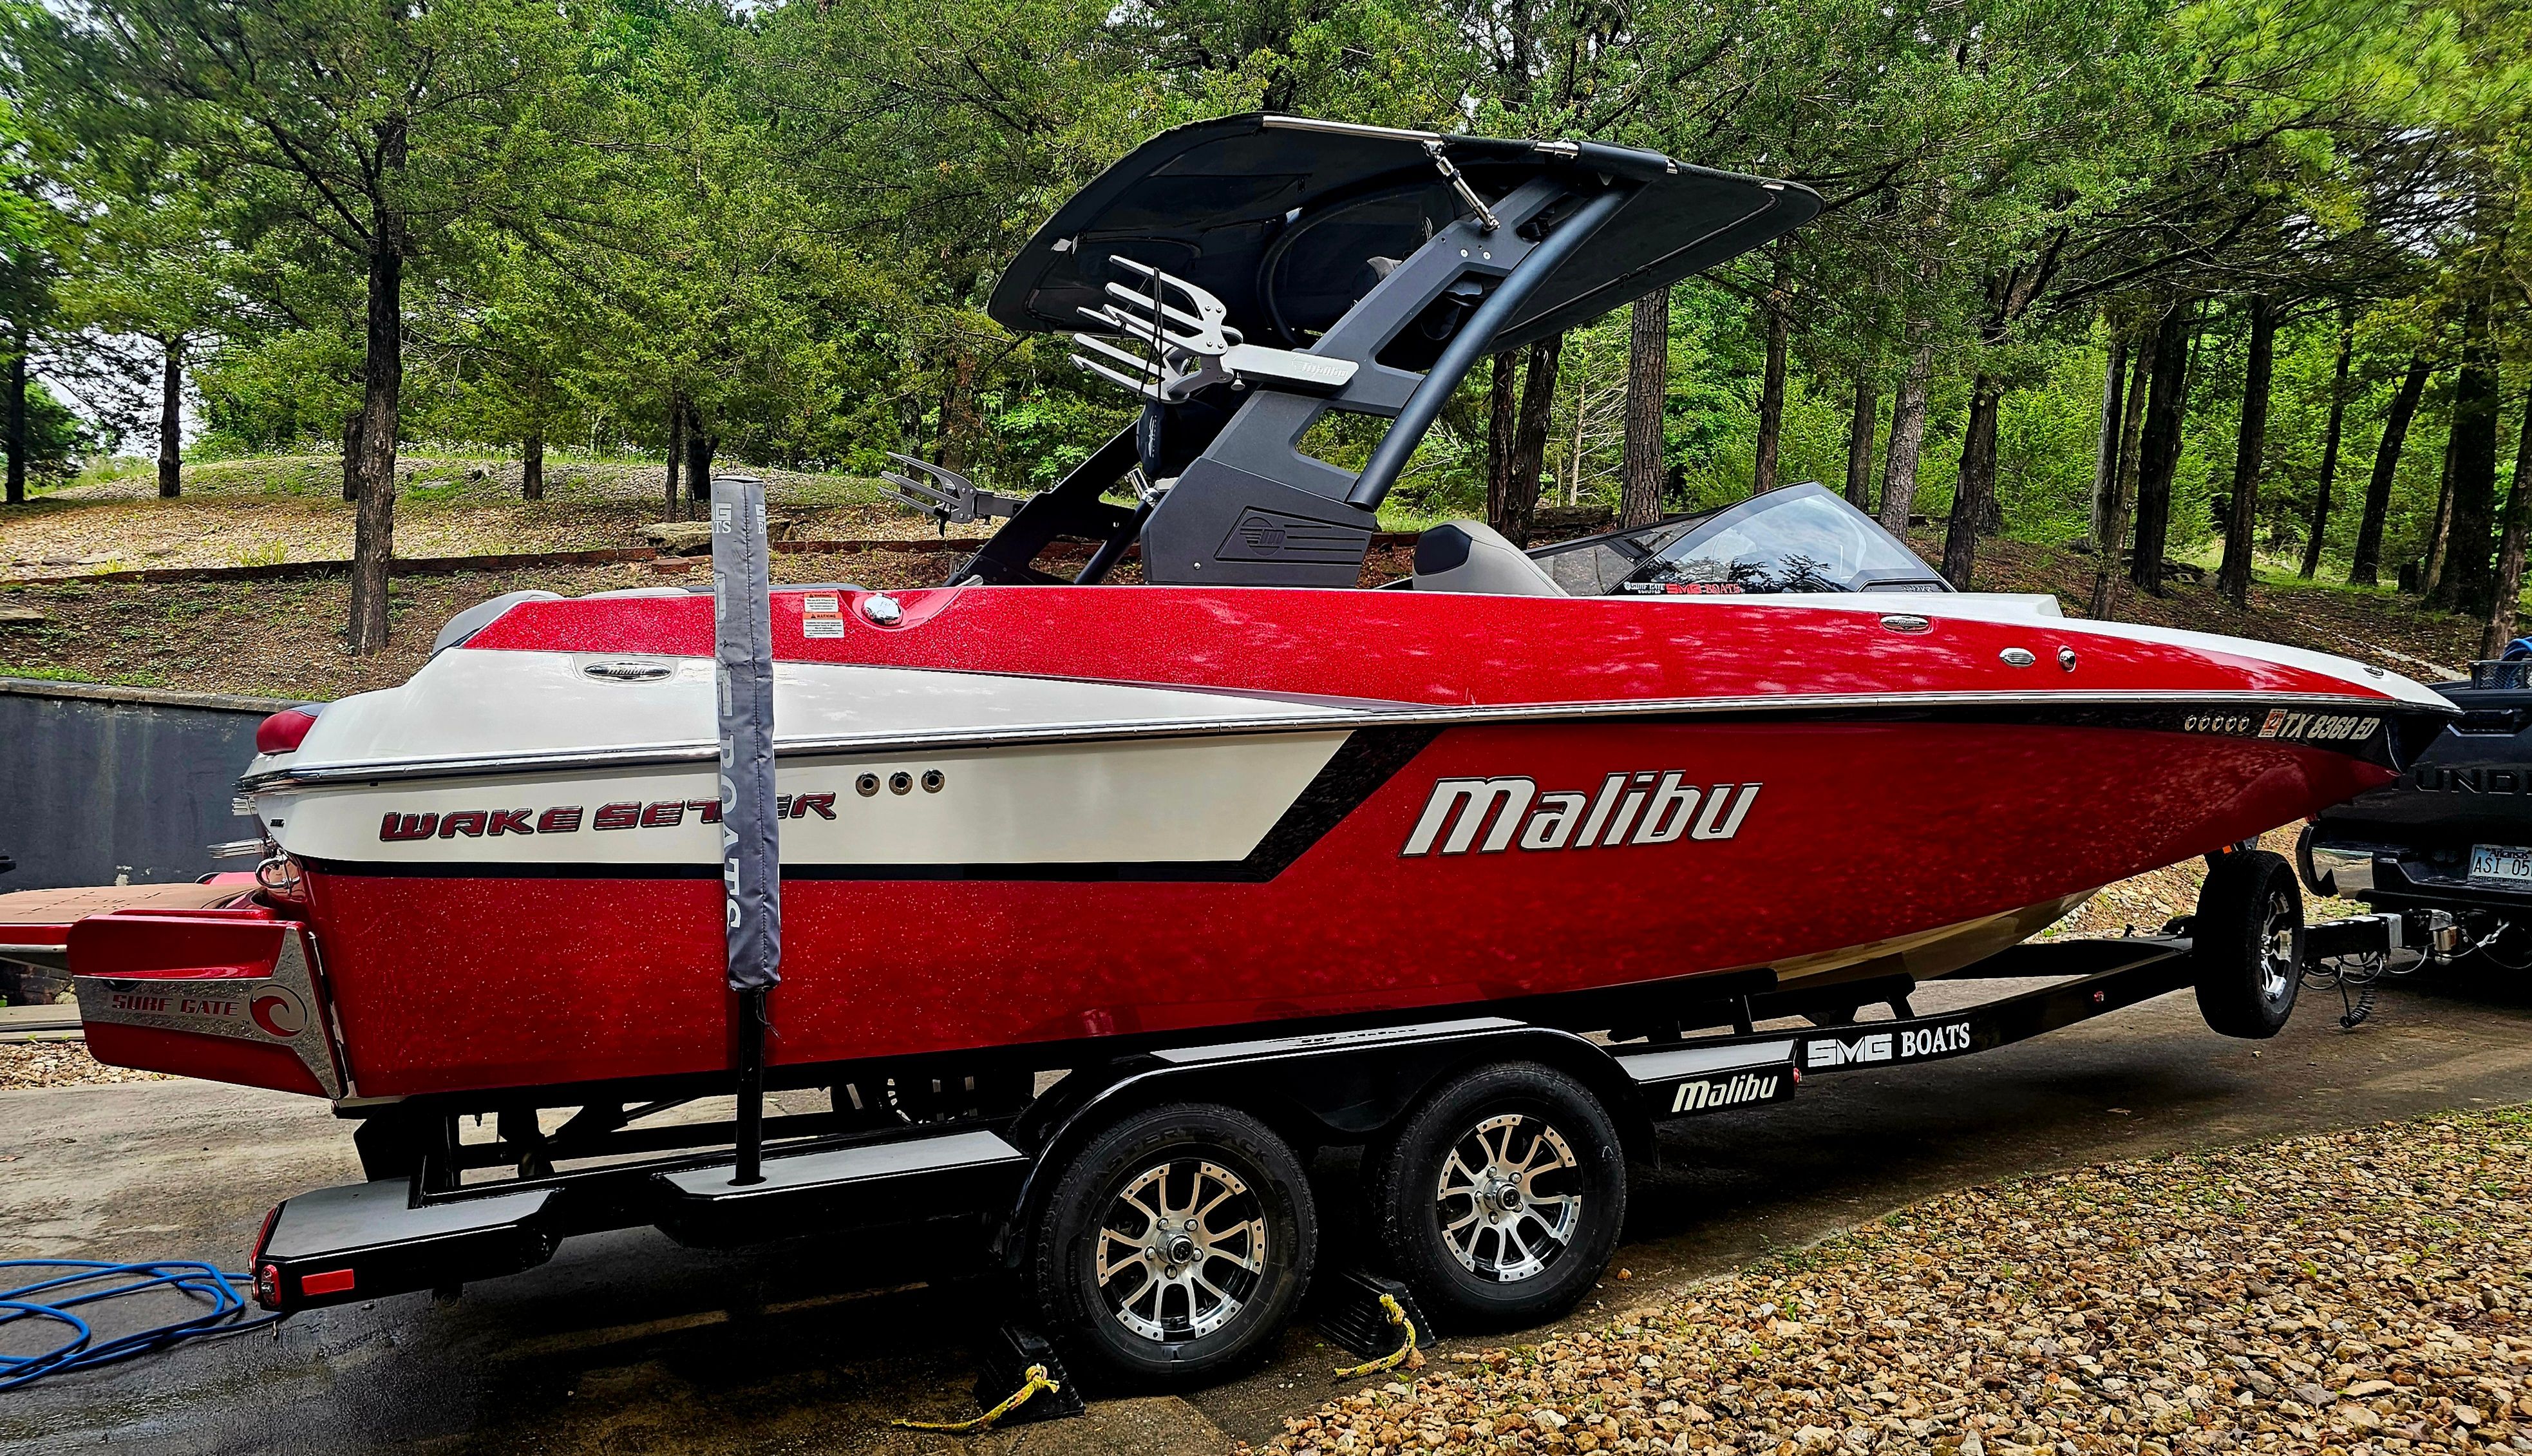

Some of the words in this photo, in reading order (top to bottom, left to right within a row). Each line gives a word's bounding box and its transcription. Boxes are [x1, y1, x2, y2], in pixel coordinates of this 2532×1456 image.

[2278, 713, 2315, 738] TX
[2307, 715, 2358, 739] 8368
[2349, 717, 2381, 740] ED
[379, 805, 584, 842] WAKE
[1397, 769, 1763, 858] Malibu
[2473, 856, 2502, 875] ASI
[112, 994, 173, 1012] SURF
[180, 999, 241, 1016] GATE
[1808, 1033, 1893, 1068] SMG
[1900, 1022, 1970, 1057] BOATS
[1671, 1073, 1778, 1112] Malibu
